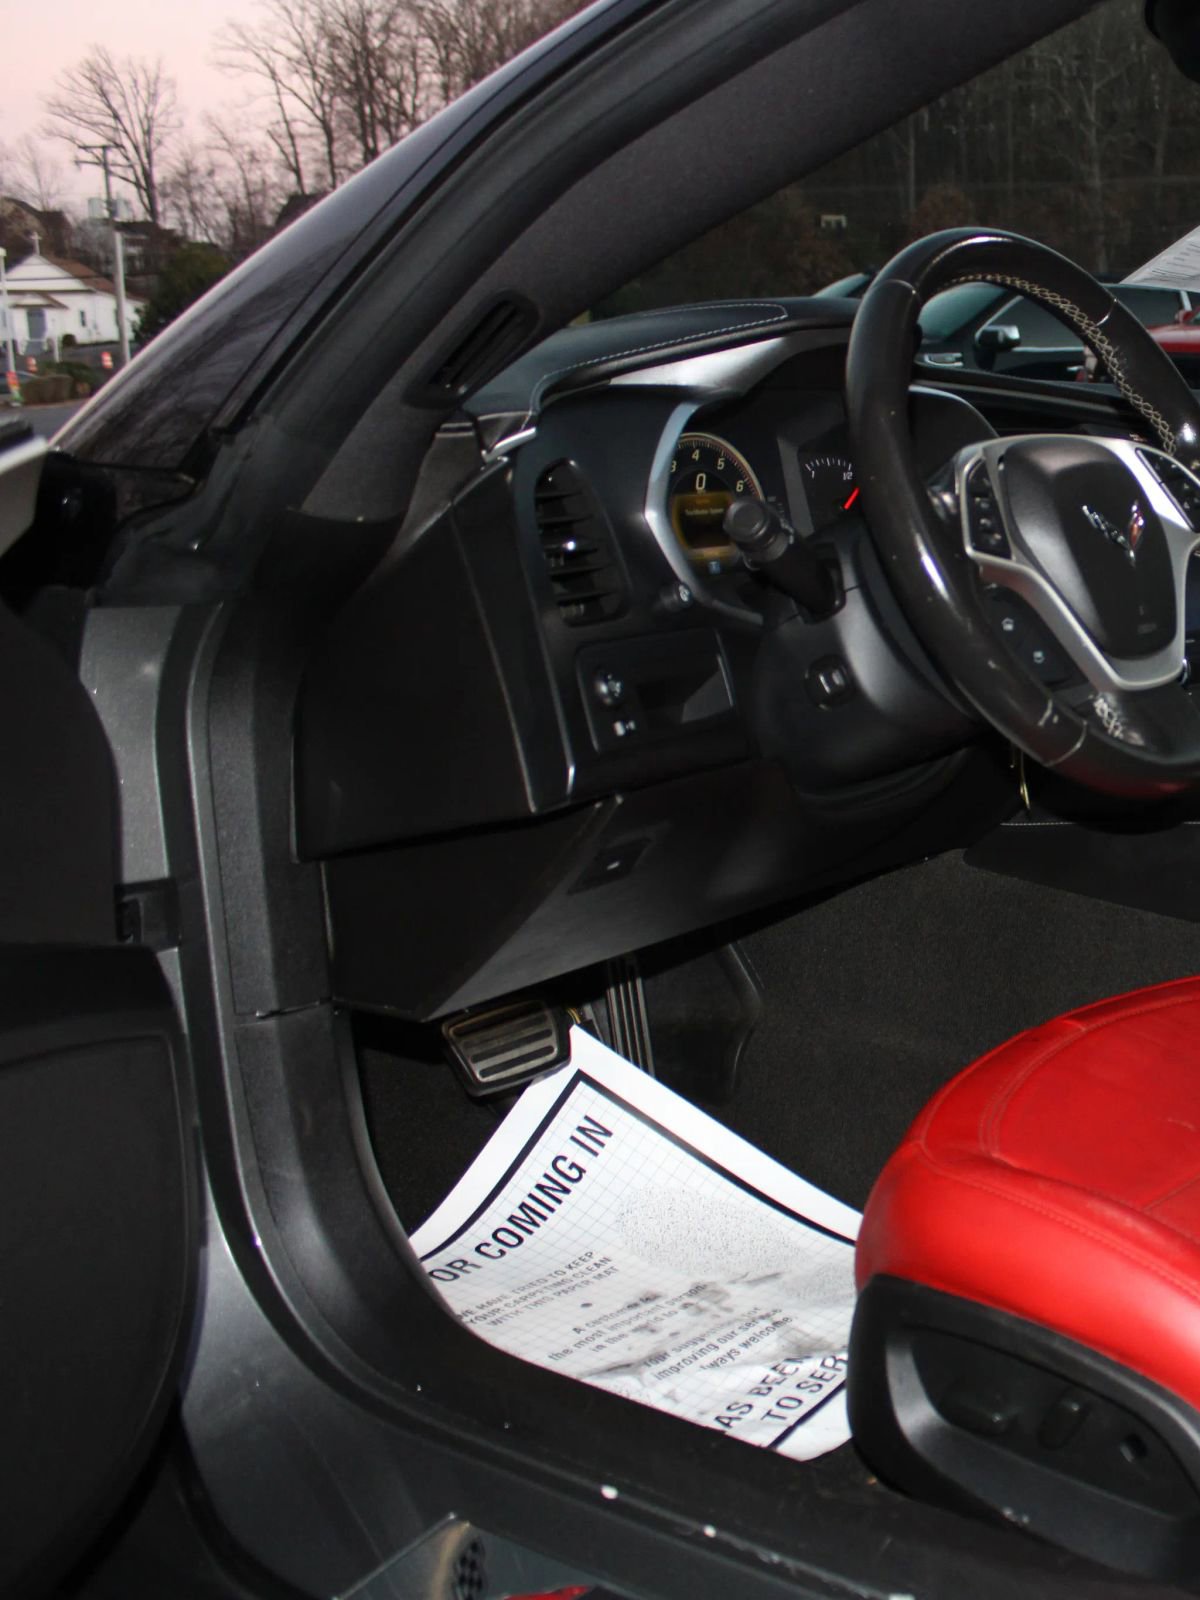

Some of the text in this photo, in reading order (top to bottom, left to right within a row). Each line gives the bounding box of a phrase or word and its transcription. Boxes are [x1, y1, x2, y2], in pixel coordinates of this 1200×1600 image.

[691, 449, 700, 461] 4
[717, 458, 725, 470] 5
[696, 473, 706, 490] 0
[736, 480, 744, 492] 6
[428, 1115, 614, 1282] OR COMING IN
[547, 1269, 567, 1280] TO
[565, 1251, 594, 1271] KEEP
[572, 1256, 612, 1279] CLEAN
[593, 1265, 619, 1281] MAT
[572, 1326, 585, 1335] A
[548, 1348, 574, 1362] the
[573, 1328, 607, 1350] most
[653, 1343, 720, 1380] improving
[716, 1330, 738, 1344] our
[760, 1354, 848, 1420] TO SER
[714, 1401, 754, 1429] AS
